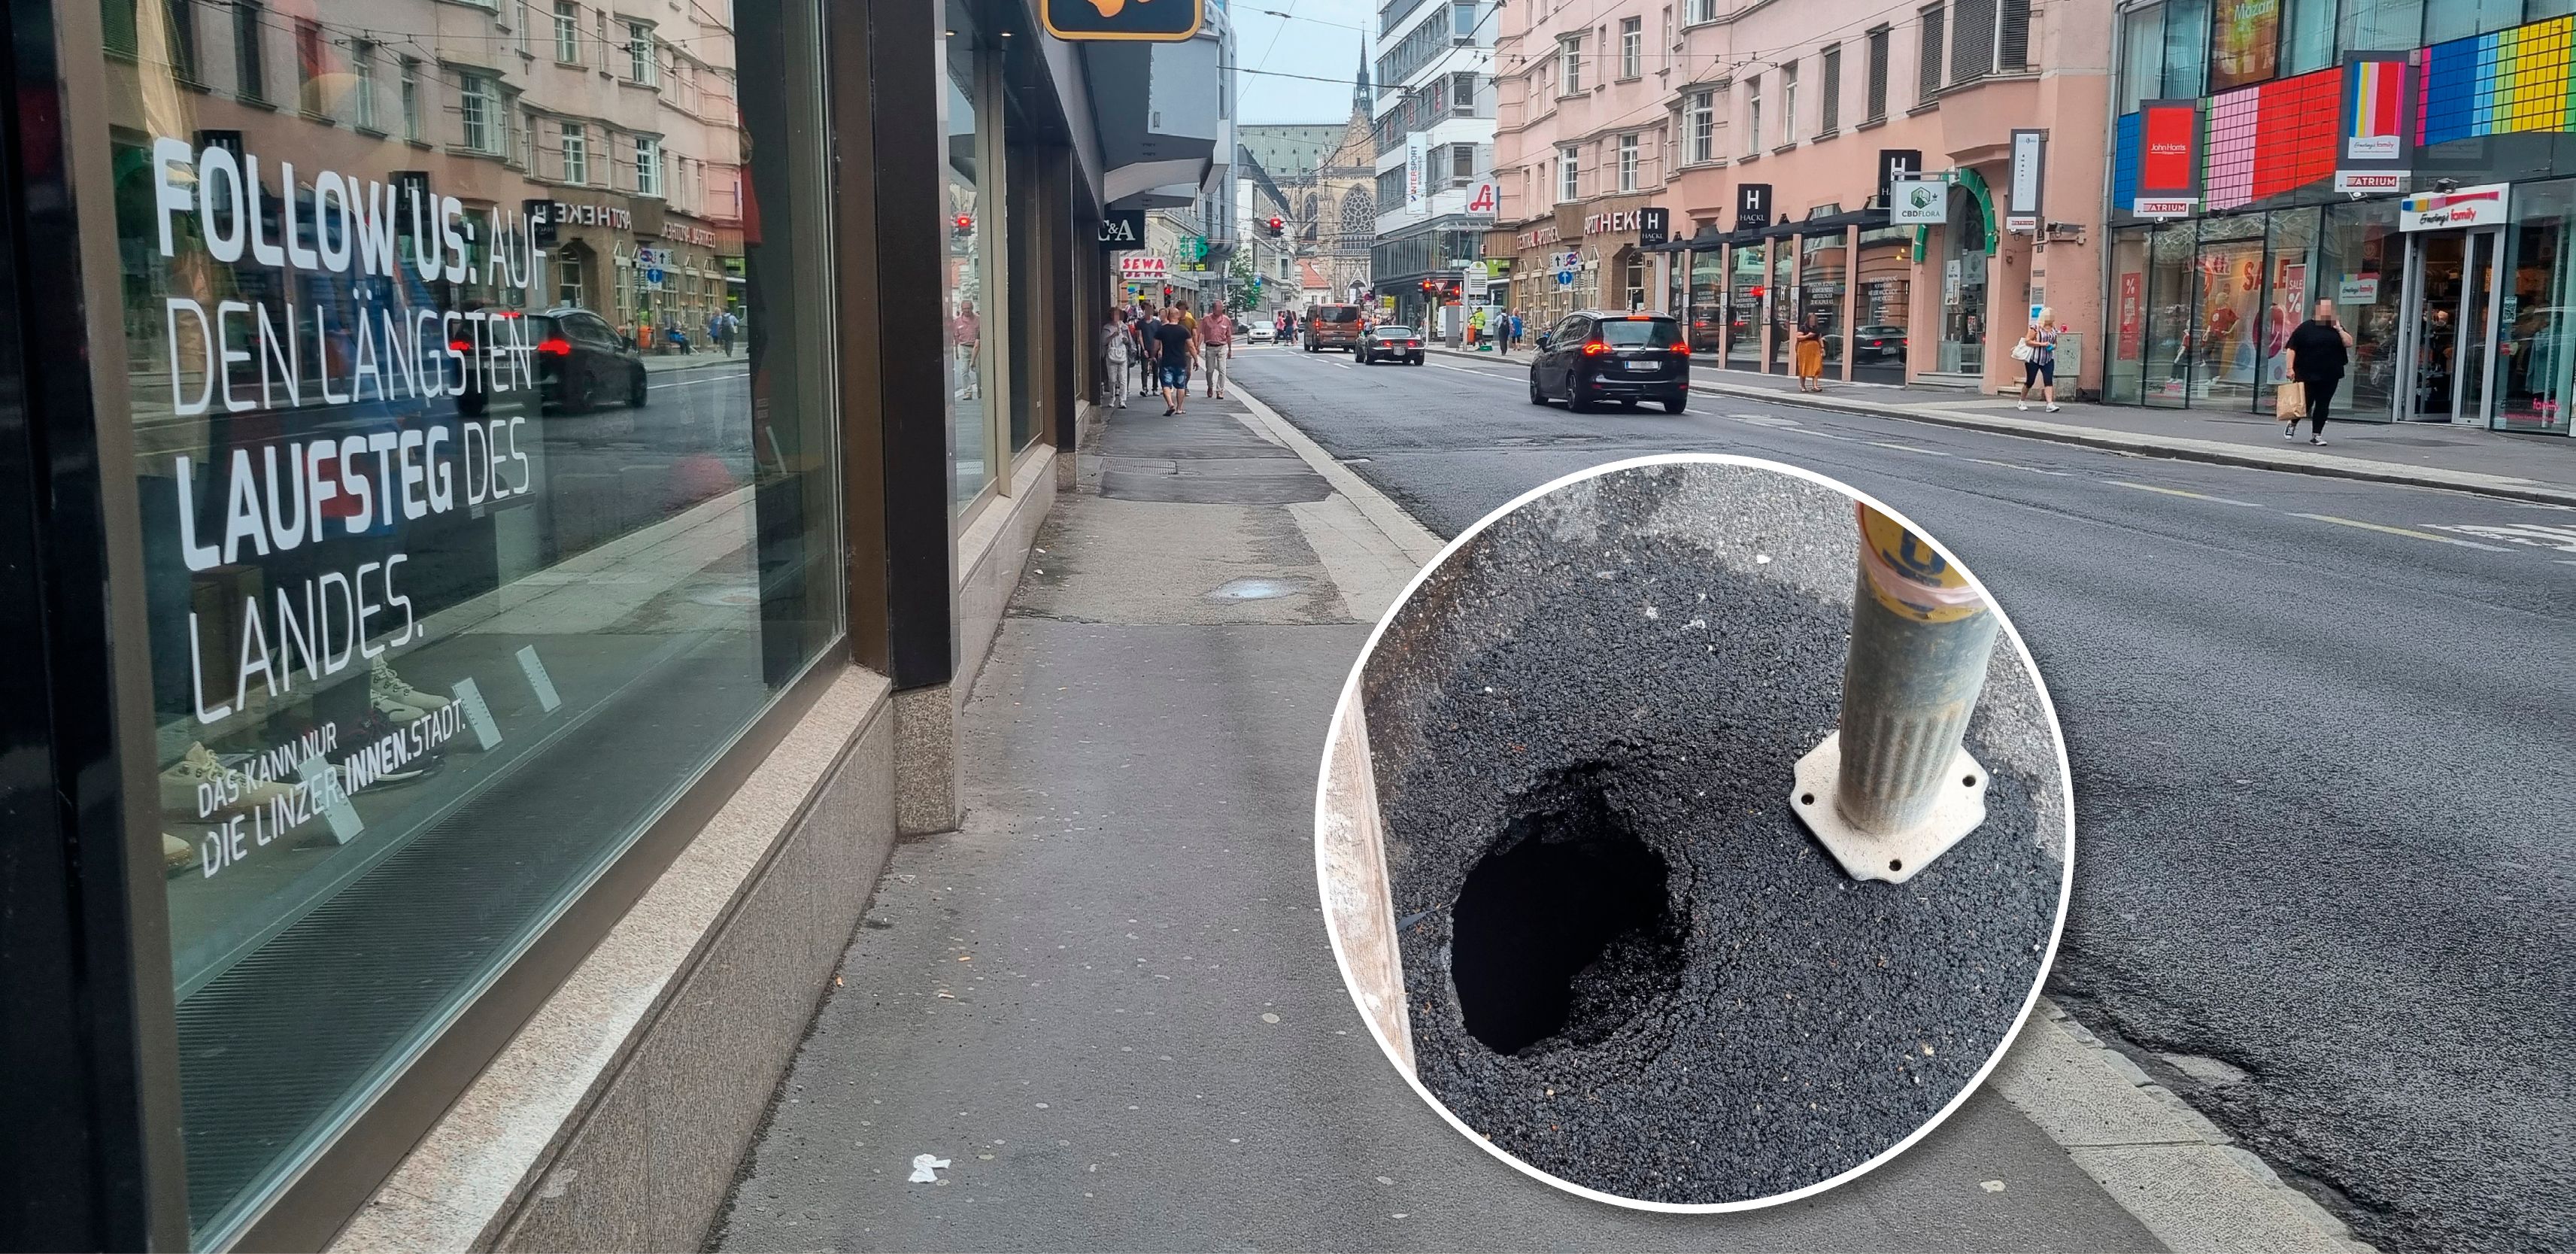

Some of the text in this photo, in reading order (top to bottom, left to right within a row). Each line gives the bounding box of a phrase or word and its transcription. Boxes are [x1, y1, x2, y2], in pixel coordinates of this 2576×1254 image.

[2152, 143, 2166, 151] John
[2355, 177, 2395, 186] ATRIUM
[1746, 190, 1759, 210] H
[153, 136, 547, 290] FOLLOW US: AUF
[1648, 213, 1658, 229] H
[2450, 207, 2477, 222] family
[1123, 258, 1164, 269] SEWA
[2289, 279, 2303, 290] SALE
[166, 288, 532, 415] DEN LÄNGSTEN
[175, 417, 529, 572] LAUFSTEG DES
[190, 554, 423, 724] LANDES.
[198, 721, 338, 818] DAS KANN NUR
[202, 814, 248, 879] DIE
